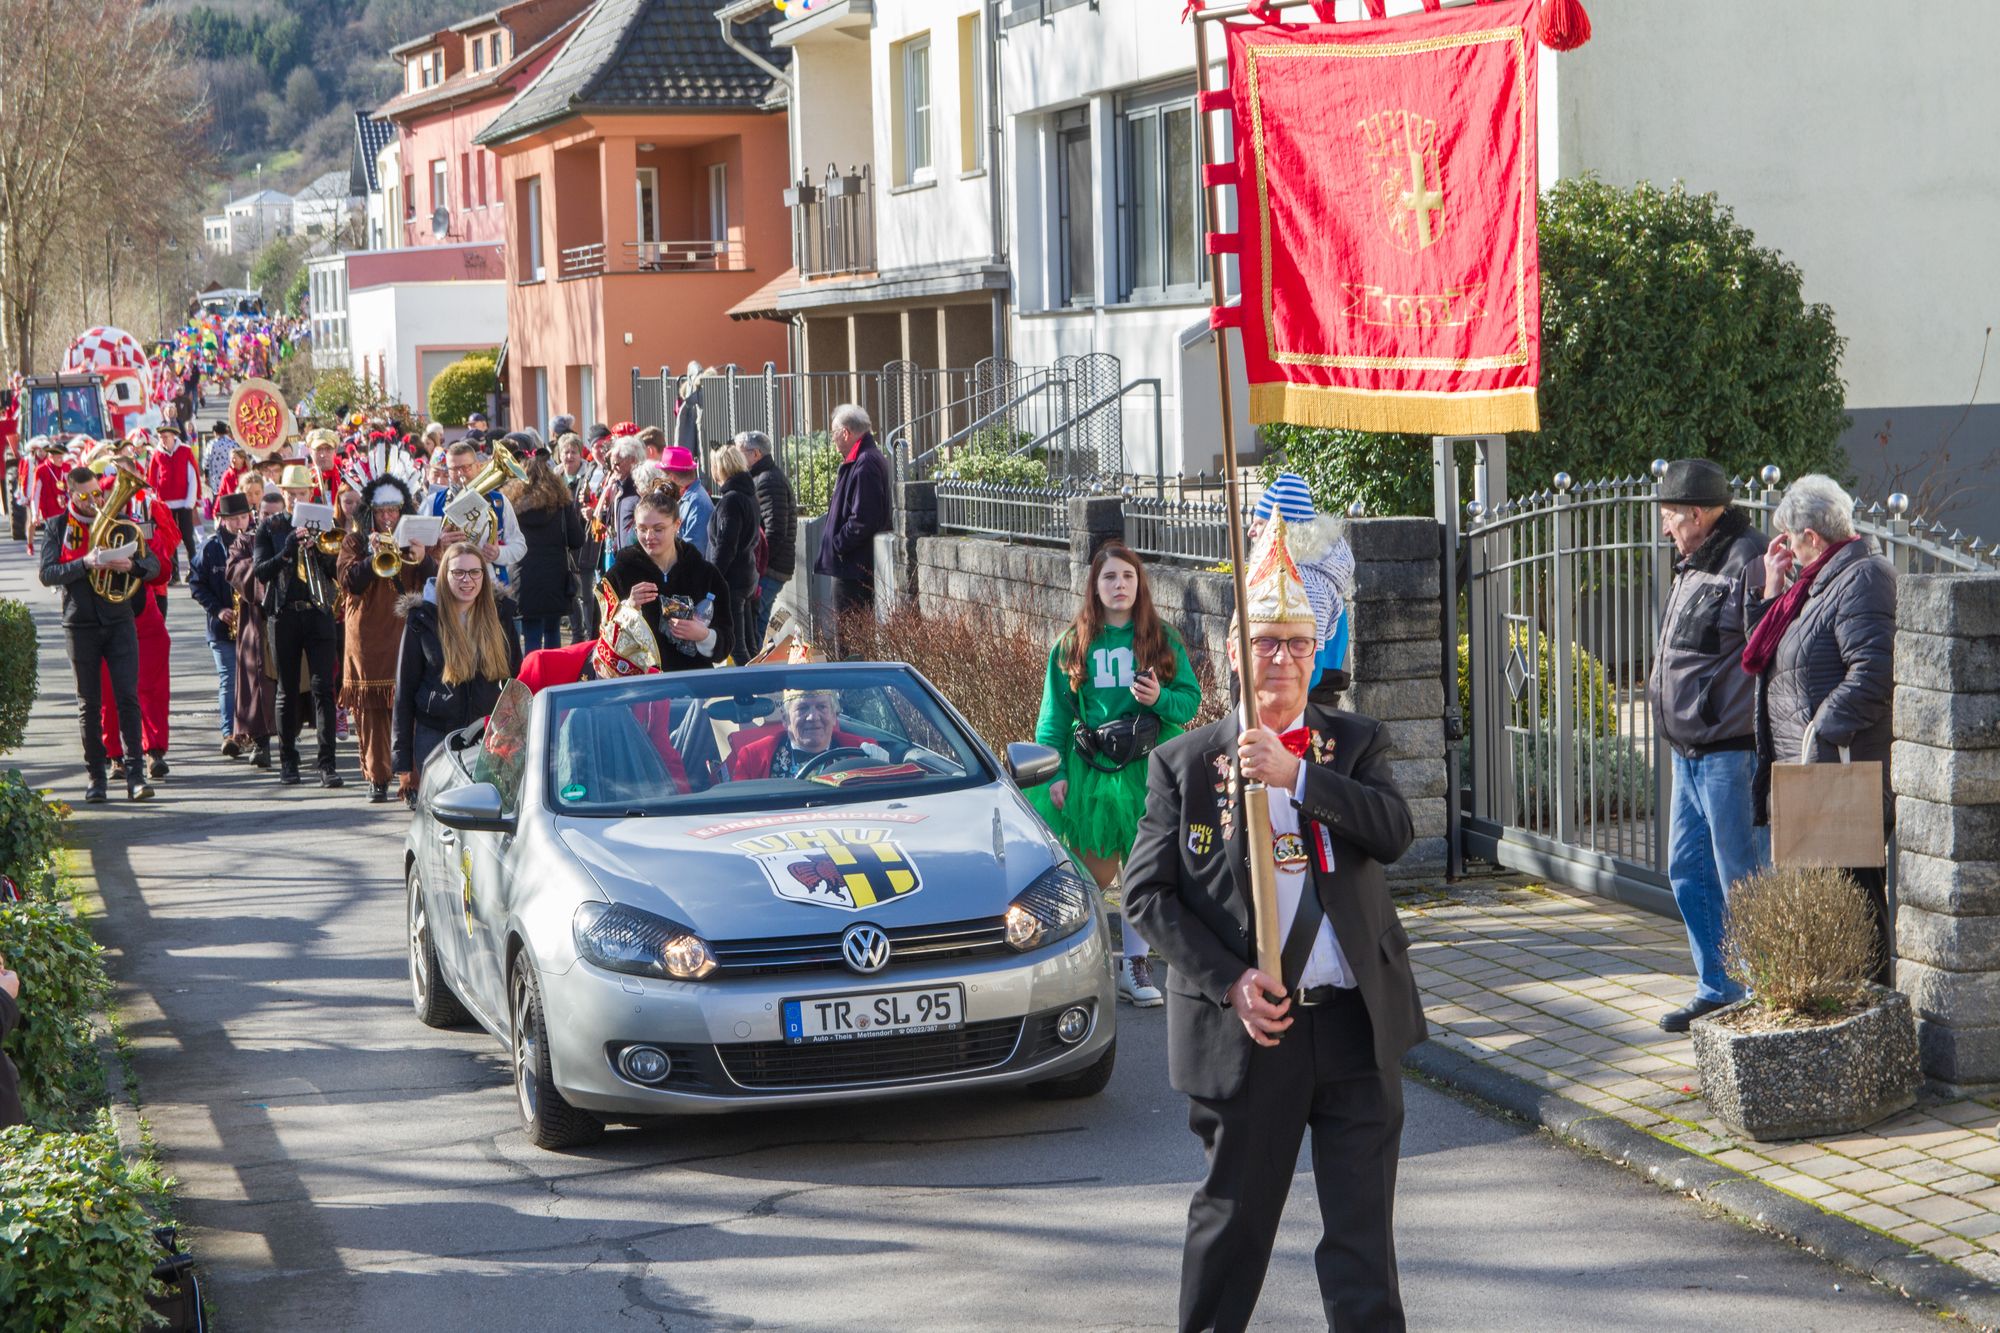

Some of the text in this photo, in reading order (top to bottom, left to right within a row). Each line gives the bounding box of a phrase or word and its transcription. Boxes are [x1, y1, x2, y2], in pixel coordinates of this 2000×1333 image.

[1382, 298, 1453, 325] 1953
[1190, 823, 1213, 836] UHU
[738, 828, 889, 855] UHU
[814, 993, 951, 1031] TR SL 95
[791, 1024, 798, 1033] D
[813, 1035, 829, 1043] Auto
[835, 1033, 853, 1041] Theis
[857, 1029, 893, 1039] Mettendorf
